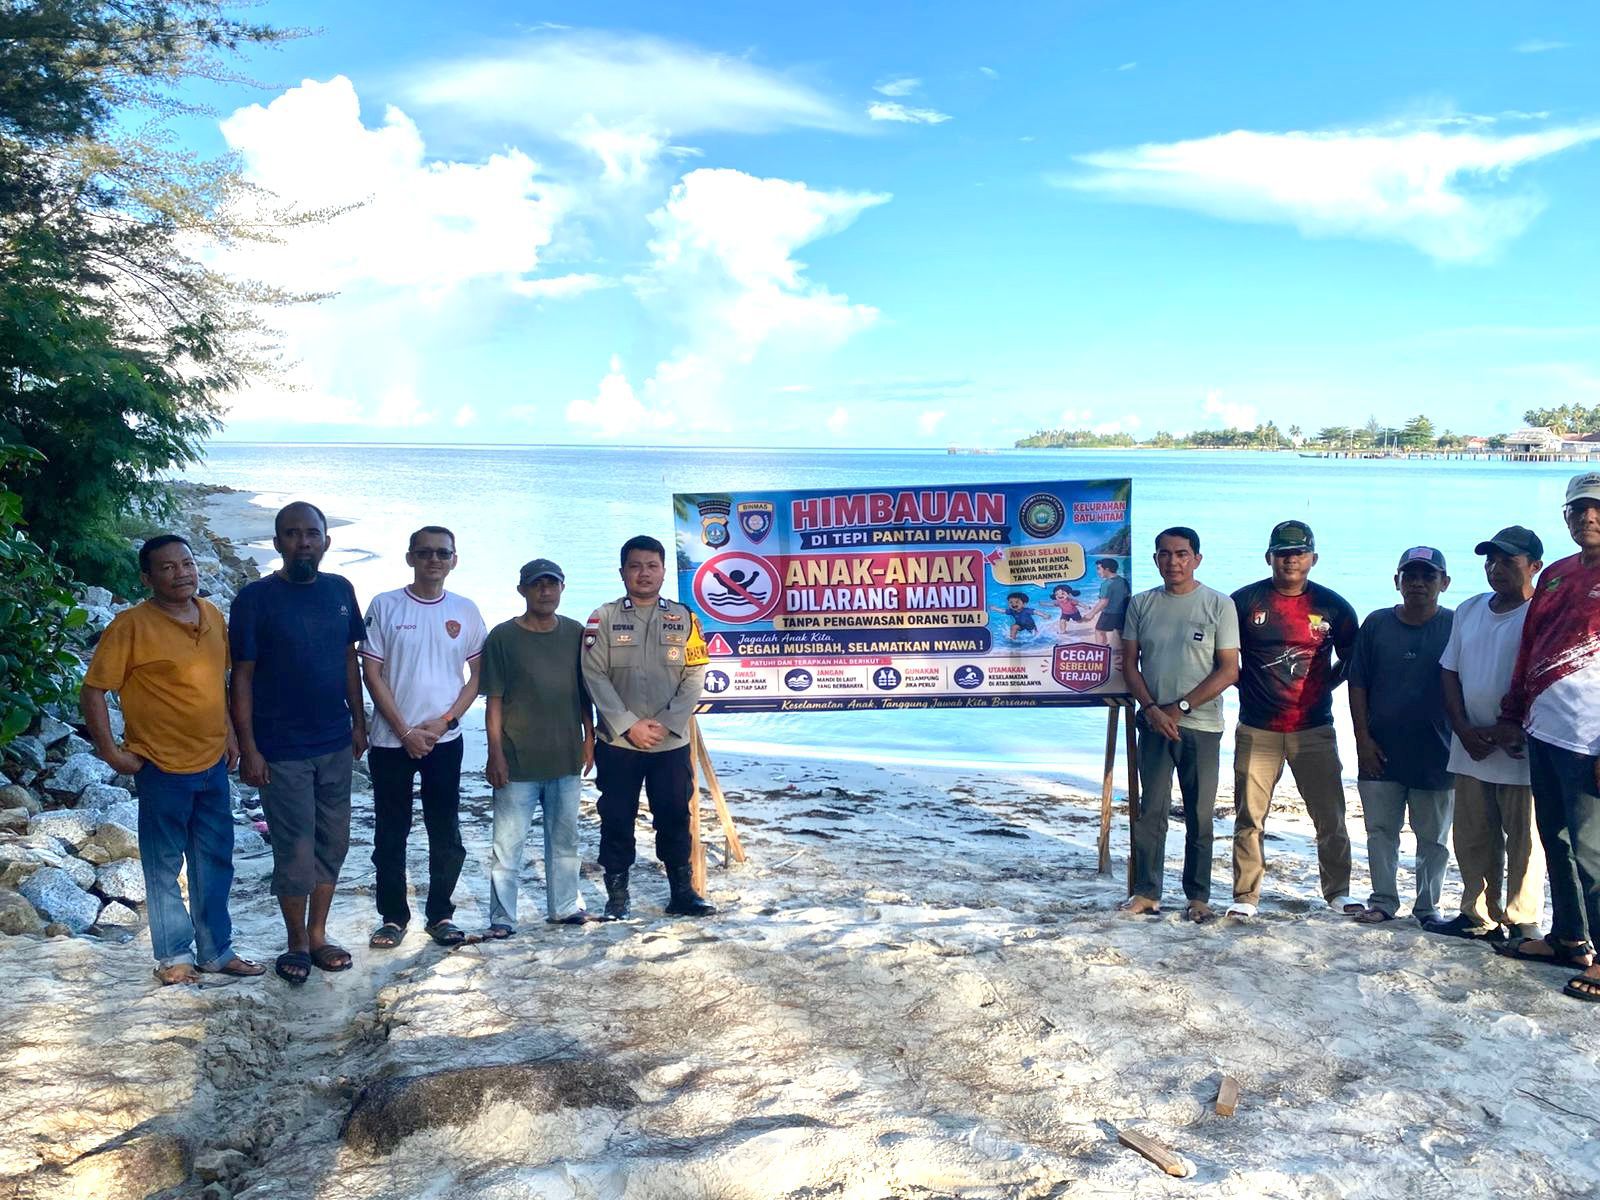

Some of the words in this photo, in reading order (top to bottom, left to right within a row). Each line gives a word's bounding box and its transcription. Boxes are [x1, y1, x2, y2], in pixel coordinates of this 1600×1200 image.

[791, 491, 1005, 531] HIMBAUAN
[1073, 501, 1126, 512] KELURAHAN
[1074, 513, 1096, 523] BATU
[1097, 512, 1124, 522] HITAM
[811, 534, 828, 546] DI
[833, 532, 867, 545] TEPI
[873, 530, 930, 543] PANTAI
[936, 529, 1001, 541] PIWANG
[1010, 549, 1036, 558] AWASI
[1039, 547, 1068, 556] SELALU
[785, 555, 975, 587] ANAK-ANAK
[1010, 566, 1037, 574] NYAWA
[1039, 564, 1069, 572] MEREKA
[1013, 573, 1062, 582] TARUHANNYA
[786, 587, 899, 612] DILARANG
[906, 585, 978, 610] MANDI
[782, 617, 820, 628] TANPA
[824, 615, 904, 627] PENGAWASAN
[908, 614, 948, 625] ORANG
[662, 623, 684, 631] POLRI
[738, 633, 778, 645] Jagalah
[781, 633, 808, 642] Anak
[738, 644, 780, 655] CEGAH
[784, 642, 845, 655] MUSIBAH,
[848, 641, 934, 653] SELAMATKAN
[1060, 649, 1104, 661] CEGAH
[905, 667, 940, 675] GUNAKAN
[1060, 661, 1103, 672] SEBELUM
[1060, 672, 1101, 682] TERJADI
[781, 700, 844, 711] Keselamatan
[881, 697, 929, 710] Tanggung
[930, 698, 963, 709] Jawab
[965, 697, 988, 707] Kita
[991, 696, 1037, 707] Bersama
